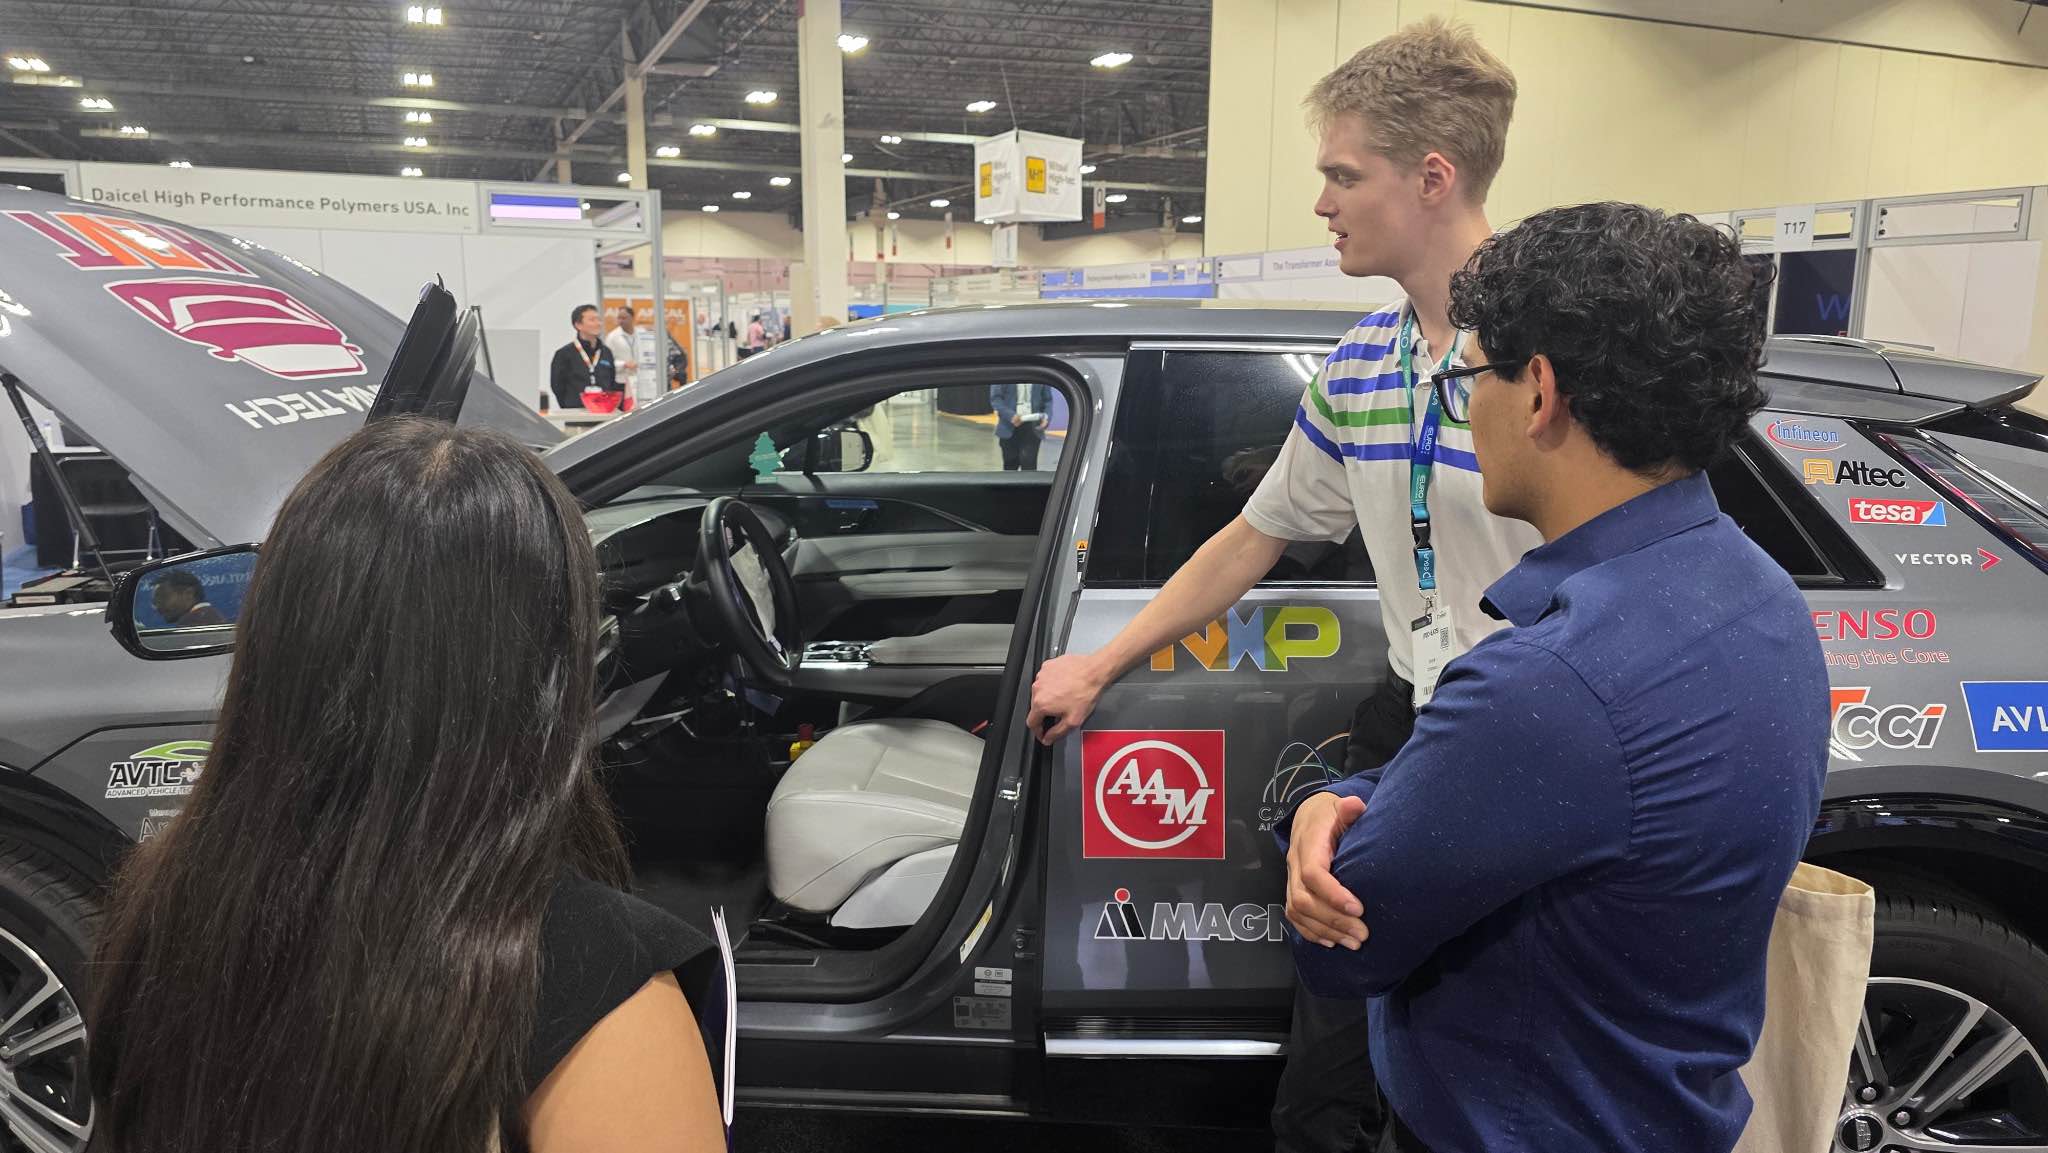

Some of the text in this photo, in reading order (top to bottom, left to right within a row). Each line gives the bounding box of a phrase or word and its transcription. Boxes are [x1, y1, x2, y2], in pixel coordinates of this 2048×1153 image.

[92, 187, 149, 203] Daicel
[154, 190, 195, 208] High
[201, 192, 315, 209] Performance
[320, 197, 400, 215] Polymers
[447, 203, 470, 217] Inc
[1783, 221, 1806, 235] T17
[1836, 460, 1907, 488] Altec
[1854, 500, 1916, 522] tesa
[1894, 553, 1973, 565] VECTOR
[1862, 649, 1898, 665] the
[1901, 648, 1950, 665] Core
[107, 760, 182, 788] AVTC
[105, 788, 146, 797] ADVANCED
[148, 787, 178, 796] VEHICLE
[1107, 759, 1215, 825] AAM
